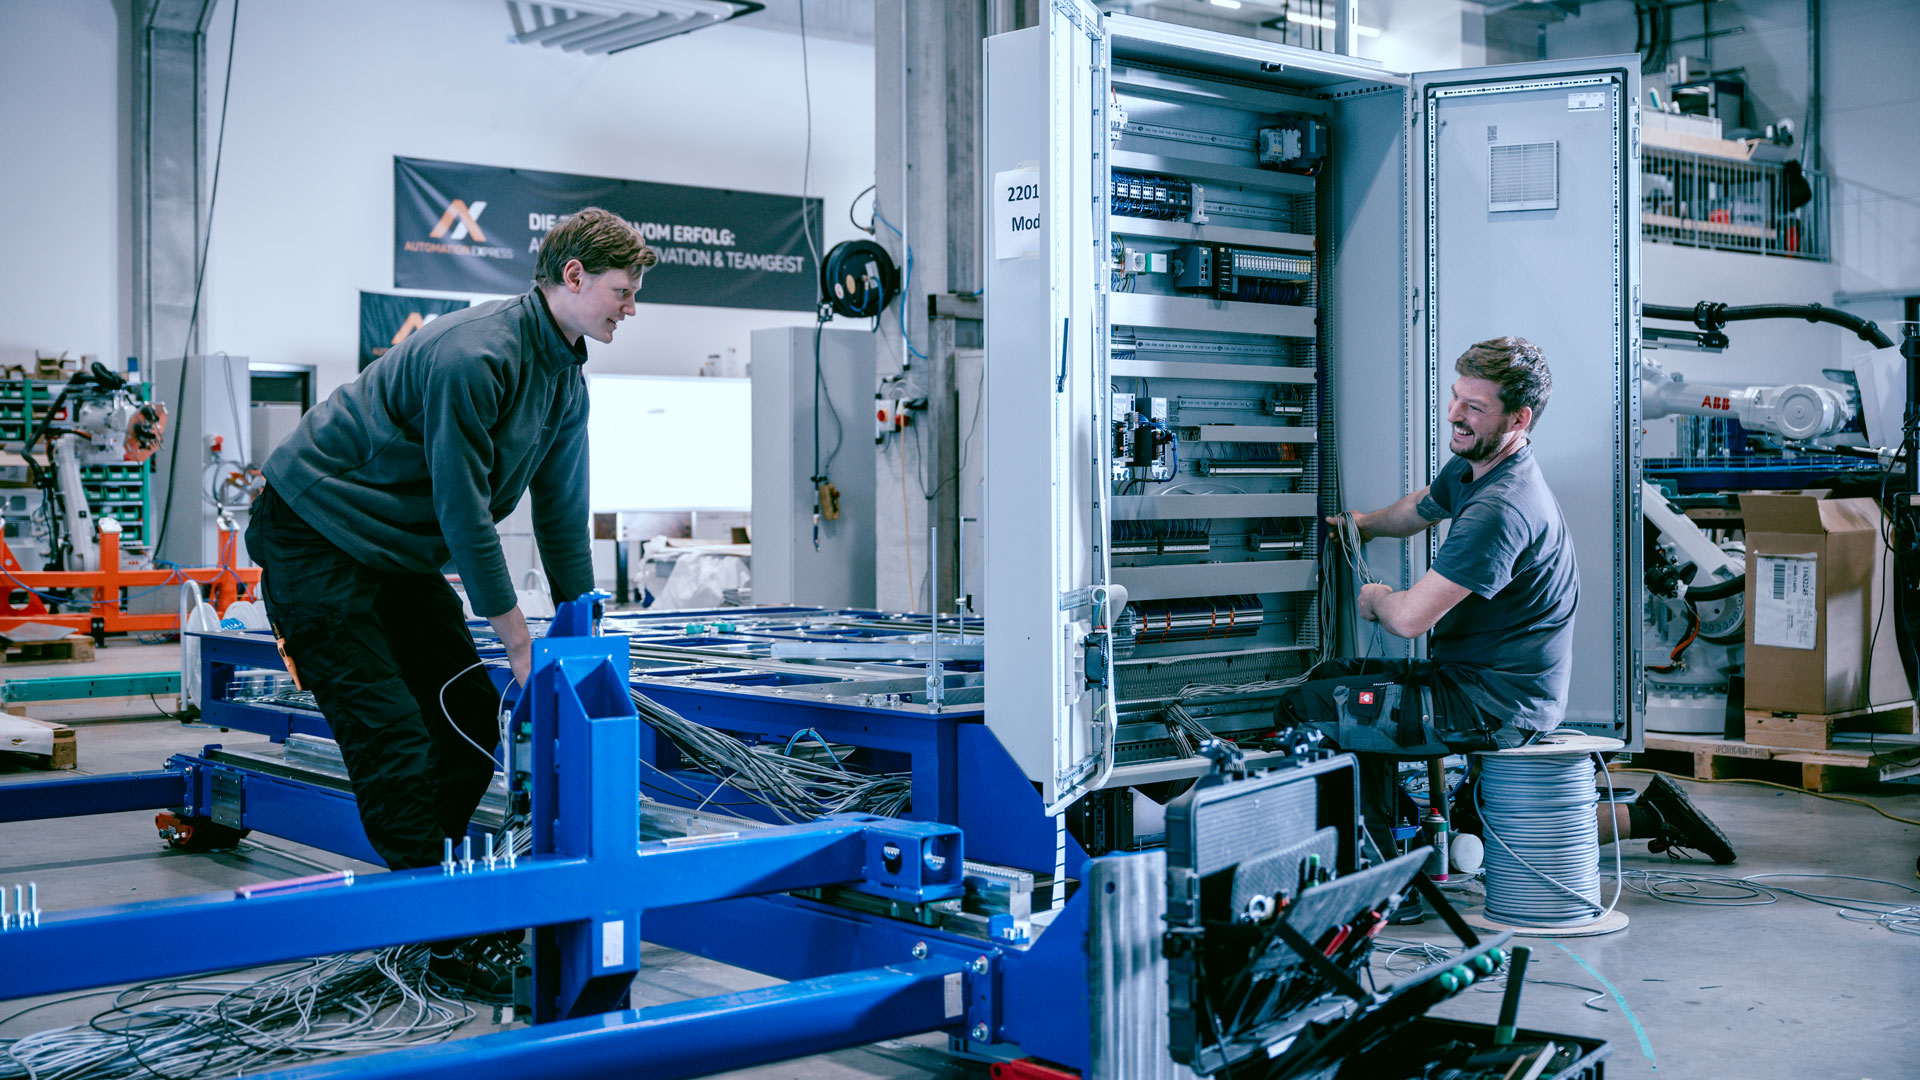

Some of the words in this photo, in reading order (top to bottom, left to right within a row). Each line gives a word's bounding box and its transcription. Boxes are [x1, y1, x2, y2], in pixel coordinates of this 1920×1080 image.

[1007, 183, 1040, 202] 2201
[528, 212, 557, 231] DIE
[673, 225, 736, 246] ERFOLG:
[1011, 212, 1040, 232] Mod
[646, 245, 711, 267] IVATION
[713, 250, 724, 267] &
[726, 251, 804, 274] TEAMGEIST
[1701, 395, 1730, 411] ABB
